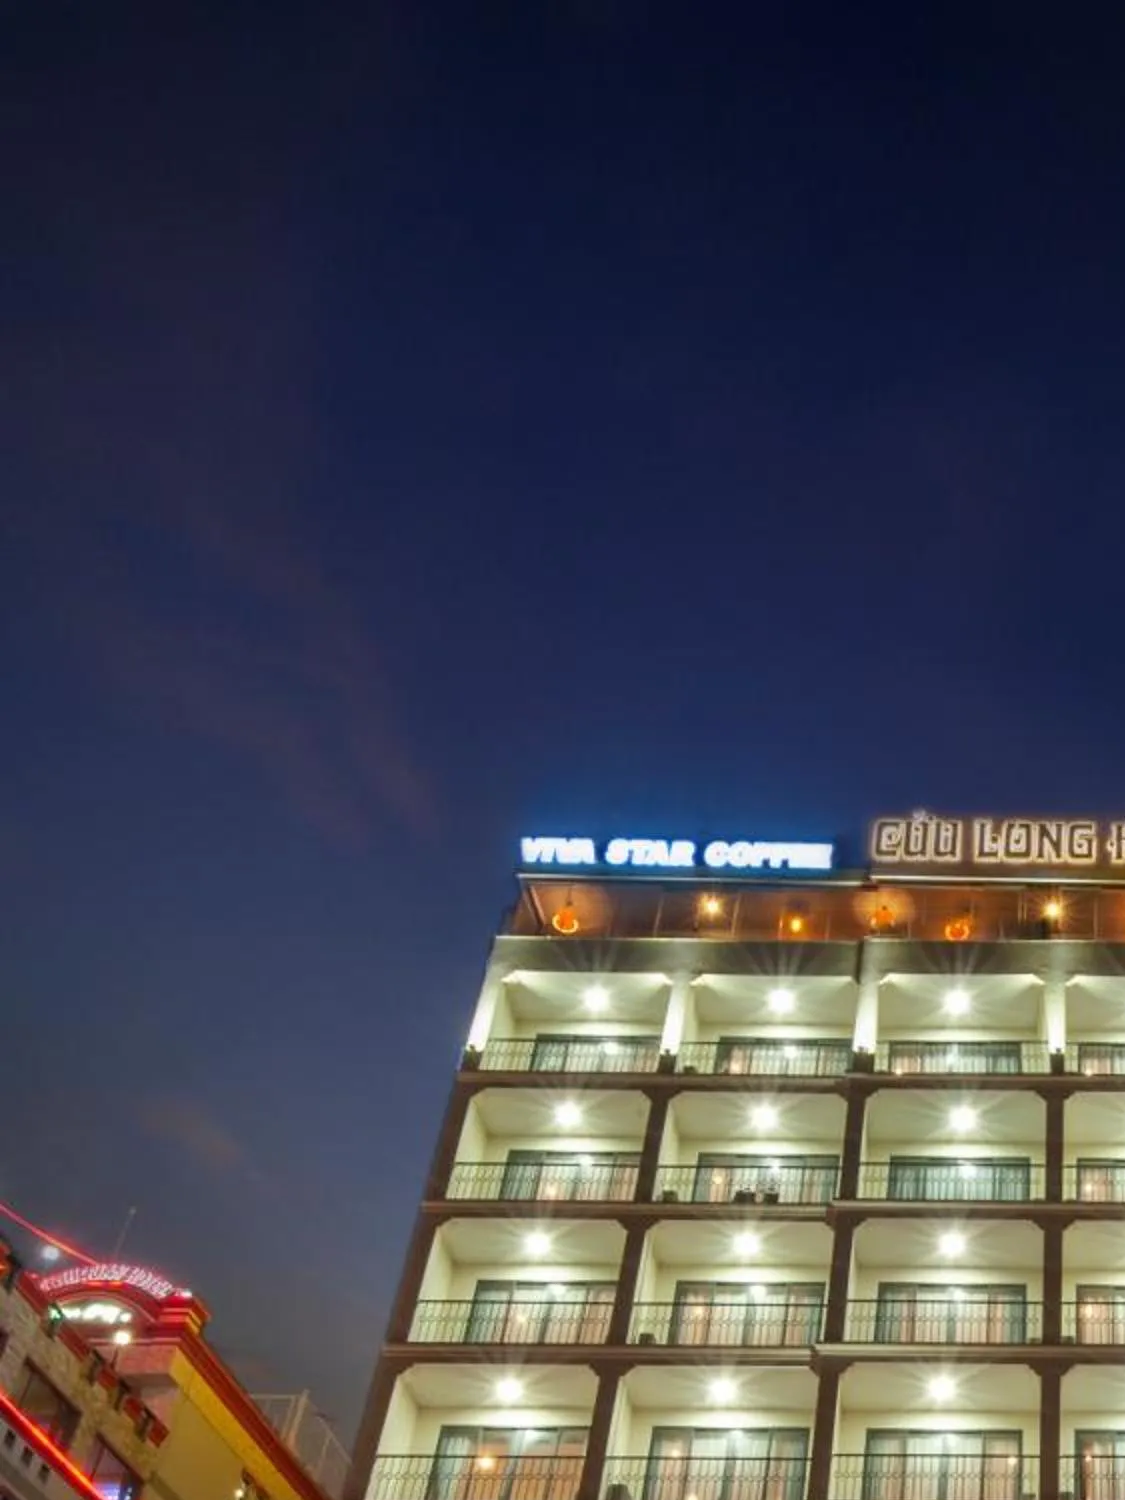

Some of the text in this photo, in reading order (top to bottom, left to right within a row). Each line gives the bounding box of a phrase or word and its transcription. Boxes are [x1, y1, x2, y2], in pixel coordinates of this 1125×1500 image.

[605, 839, 695, 867] STAR
[703, 841, 833, 869] COFF
[973, 819, 1097, 864] LONG
